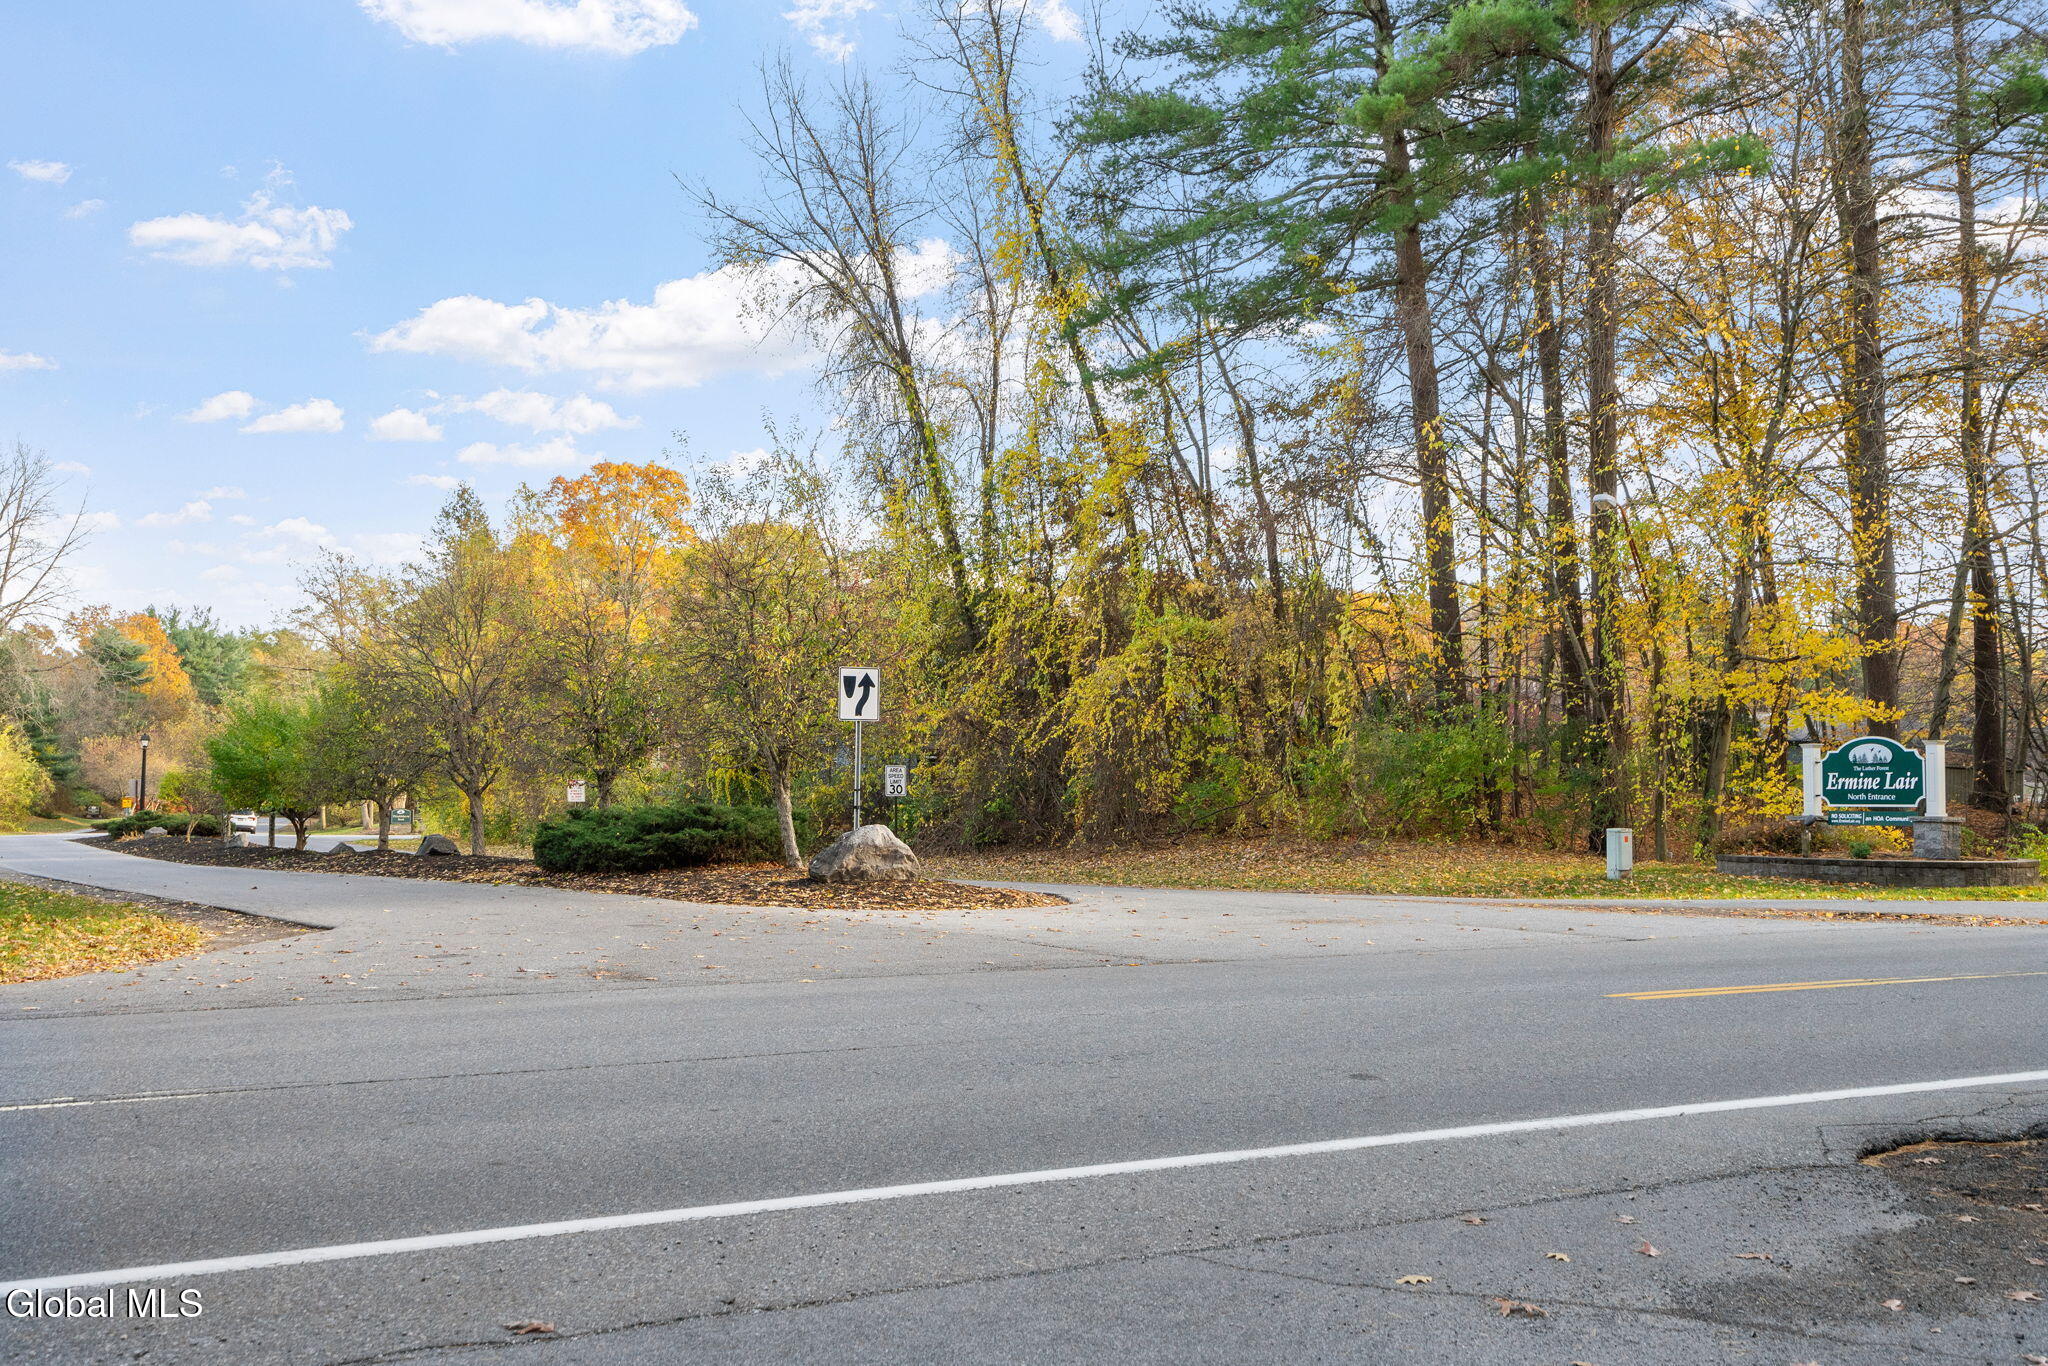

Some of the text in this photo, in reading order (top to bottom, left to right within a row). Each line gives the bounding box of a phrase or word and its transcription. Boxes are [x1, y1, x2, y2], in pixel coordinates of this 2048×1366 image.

[1826, 771, 1918, 790] Ermine Lair
[890, 785, 903, 794] 30
